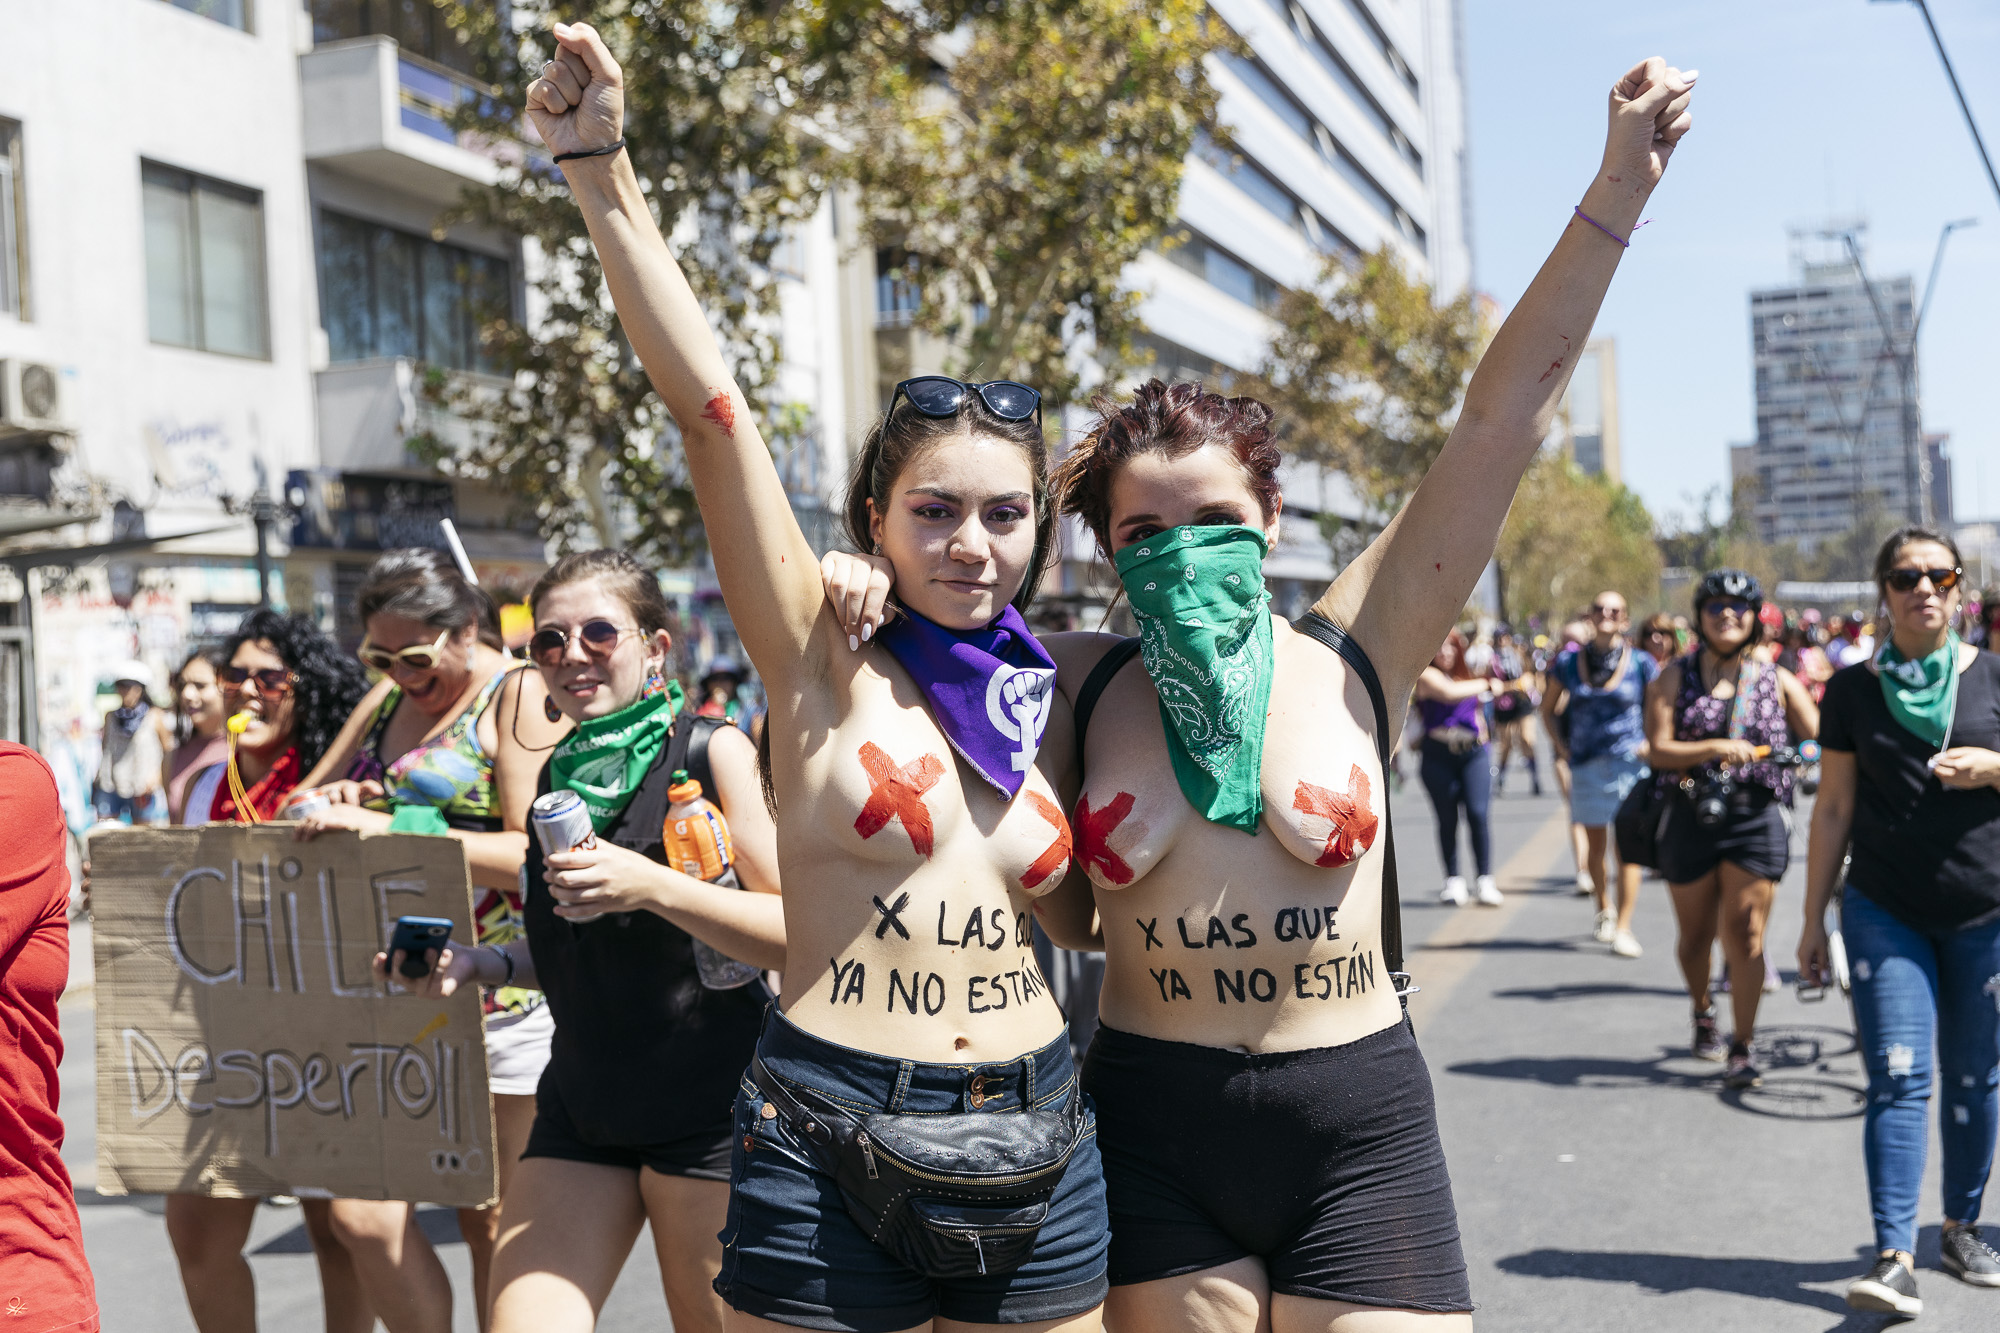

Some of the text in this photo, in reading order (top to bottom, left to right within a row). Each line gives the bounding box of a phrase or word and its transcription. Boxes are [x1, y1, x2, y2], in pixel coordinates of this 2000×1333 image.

[675, 820, 688, 835] G
[872, 891, 1035, 951] X LAS QU
[1136, 906, 1340, 951] X LAS QUE
[830, 956, 1046, 1016] YA NO ESTÁN
[1149, 941, 1376, 1005] YA NO ESTÁN
